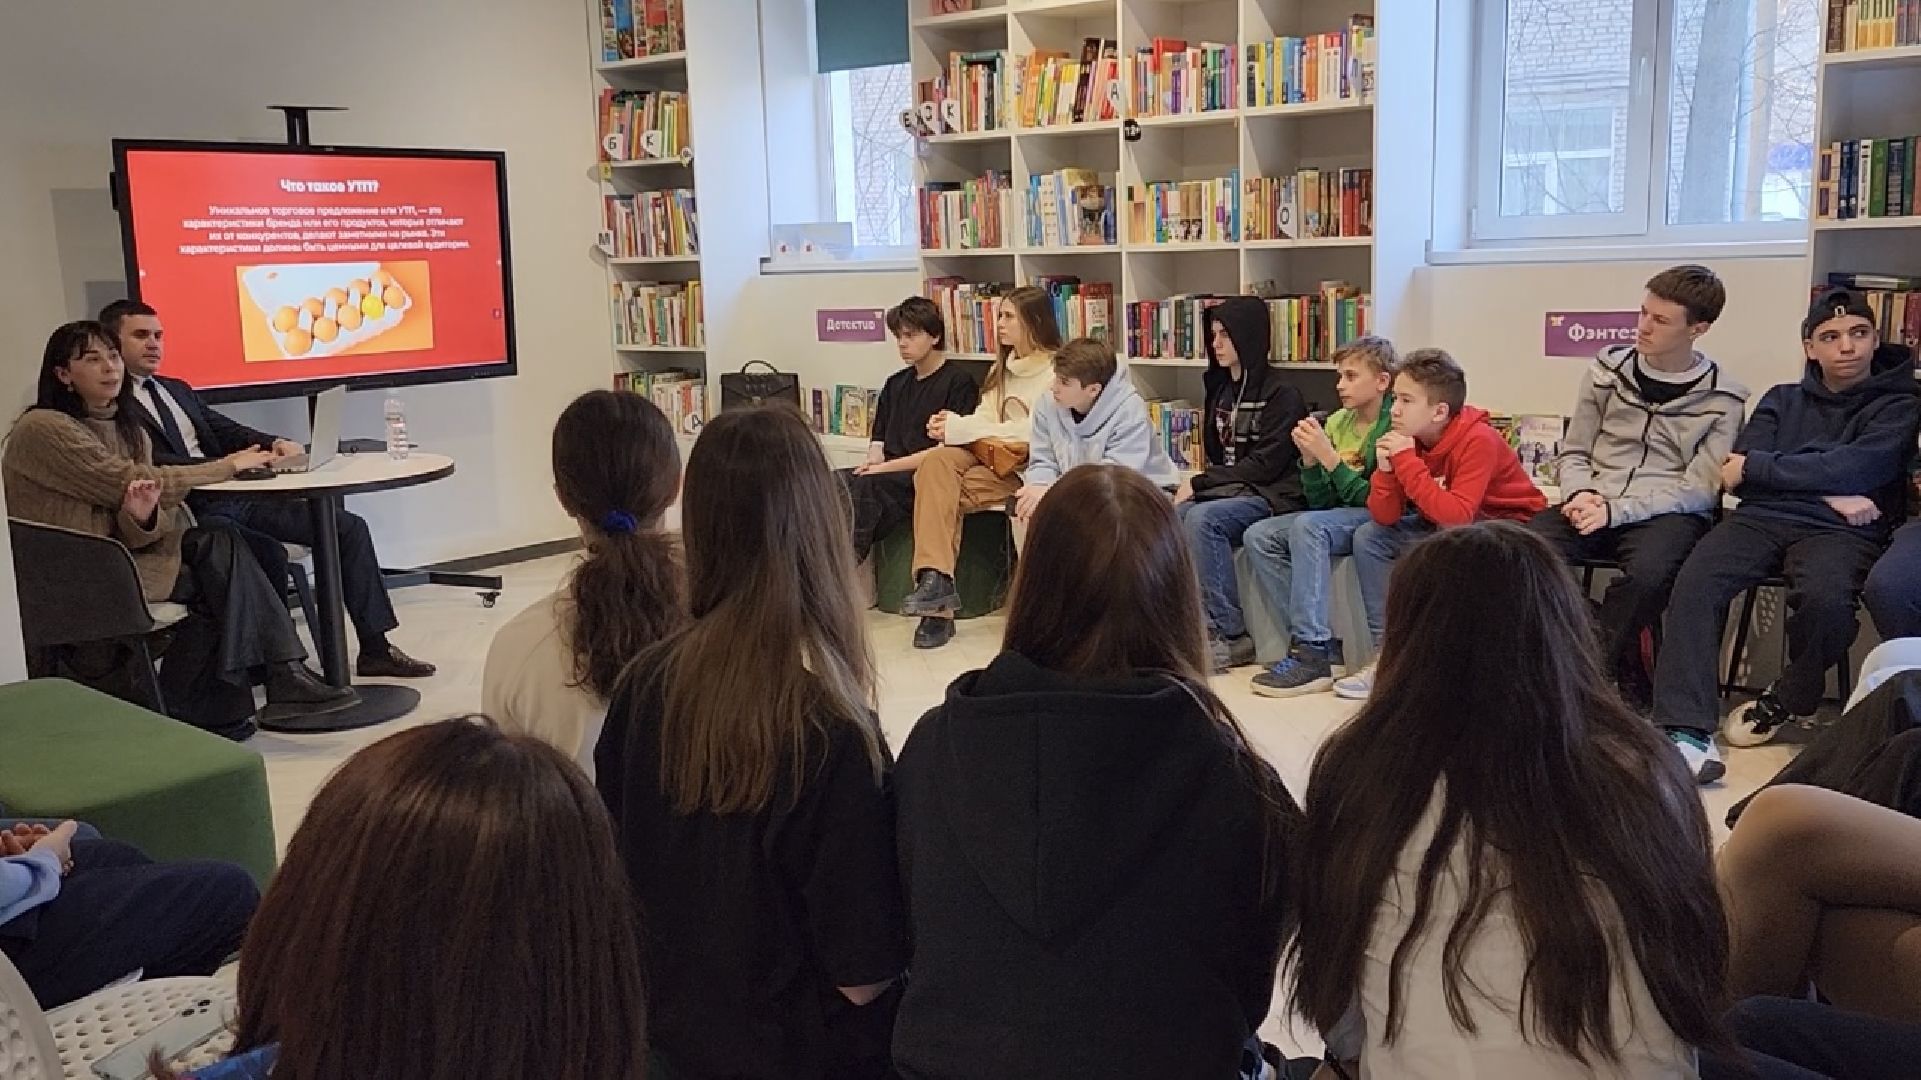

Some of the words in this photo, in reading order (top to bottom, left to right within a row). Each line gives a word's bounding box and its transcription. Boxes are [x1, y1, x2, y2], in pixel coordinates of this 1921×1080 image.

[280, 178, 306, 193] Что
[306, 181, 346, 193] такое
[346, 179, 379, 193] УТП?
[208, 205, 271, 216] Уникальное
[271, 206, 316, 216] торговое
[316, 206, 379, 216] предложение
[380, 206, 397, 216] или
[397, 205, 418, 216] УТП,
[428, 206, 443, 216] это
[183, 219, 265, 231] характеристики
[265, 217, 301, 229] бренда
[302, 219, 321, 228] или
[322, 219, 340, 228] его
[388, 218, 424, 228] которые
[425, 218, 464, 227] отличают
[208, 232, 222, 241] их
[223, 232, 235, 241] от
[236, 231, 301, 243] конкурентов,
[302, 231, 337, 241] делают
[337, 230, 388, 240] заметными
[388, 229, 400, 239] на
[429, 227, 446, 238] Эти
[179, 244, 261, 256] характеристики
[262, 244, 302, 254] должны
[302, 241, 326, 253] быть
[326, 242, 370, 252] ценными
[370, 242, 386, 252] для
[387, 239, 424, 251] целевой
[826, 318, 877, 333] Детектив
[1568, 322, 1639, 342] Фэнтез
